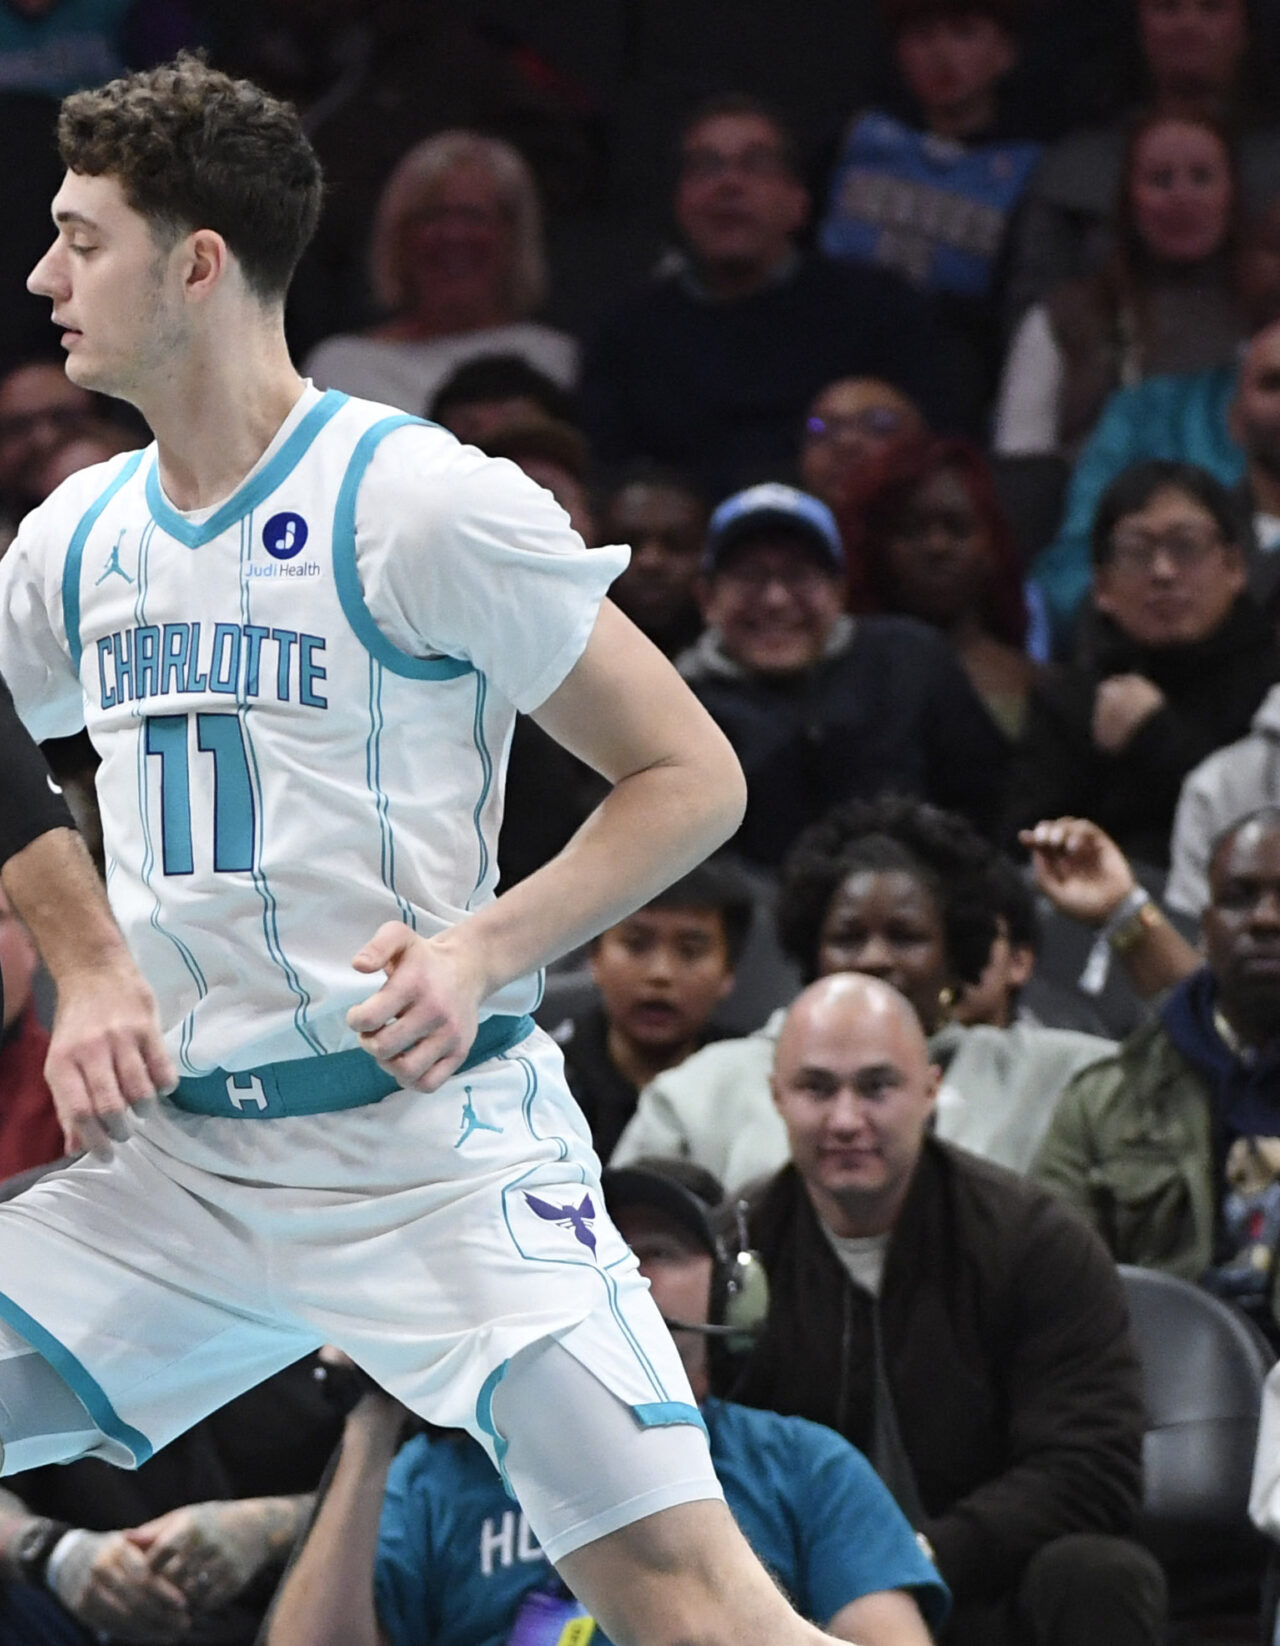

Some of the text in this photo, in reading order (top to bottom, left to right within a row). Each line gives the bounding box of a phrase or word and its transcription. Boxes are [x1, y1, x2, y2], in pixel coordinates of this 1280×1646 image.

[245, 561, 321, 577] Judi Health
[96, 622, 328, 710] CHARLOTTE
[146, 713, 256, 876] 11
